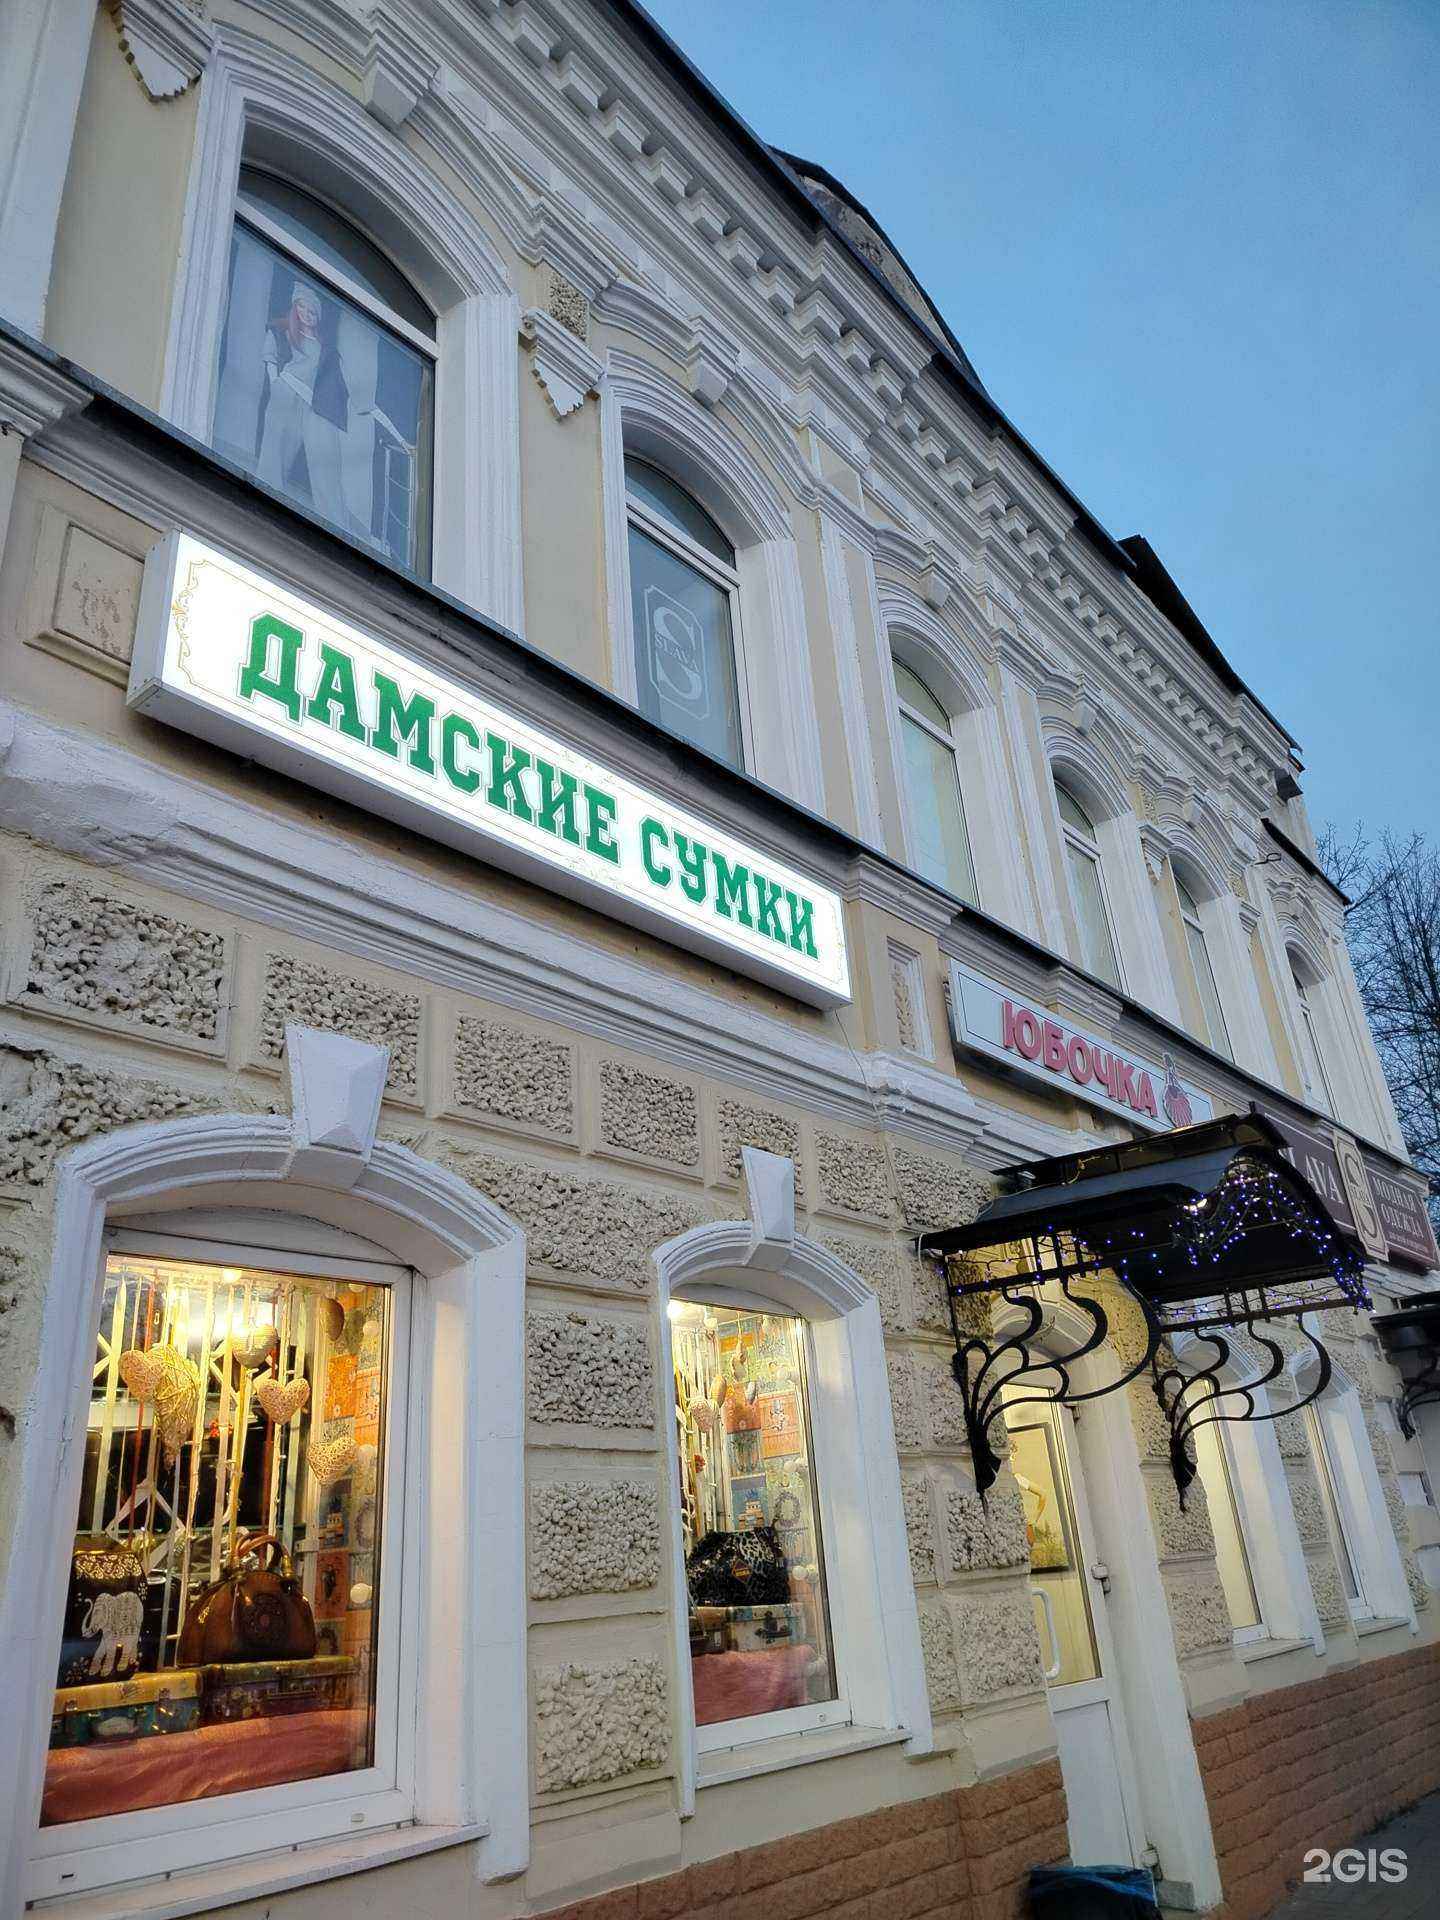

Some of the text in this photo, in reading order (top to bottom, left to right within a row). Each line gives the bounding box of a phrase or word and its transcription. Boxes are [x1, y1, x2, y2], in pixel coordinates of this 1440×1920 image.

[237, 610, 819, 960] ДАМСКИЕ СУМКИ
[1002, 1000, 1158, 1118] ЮБОЧКА
